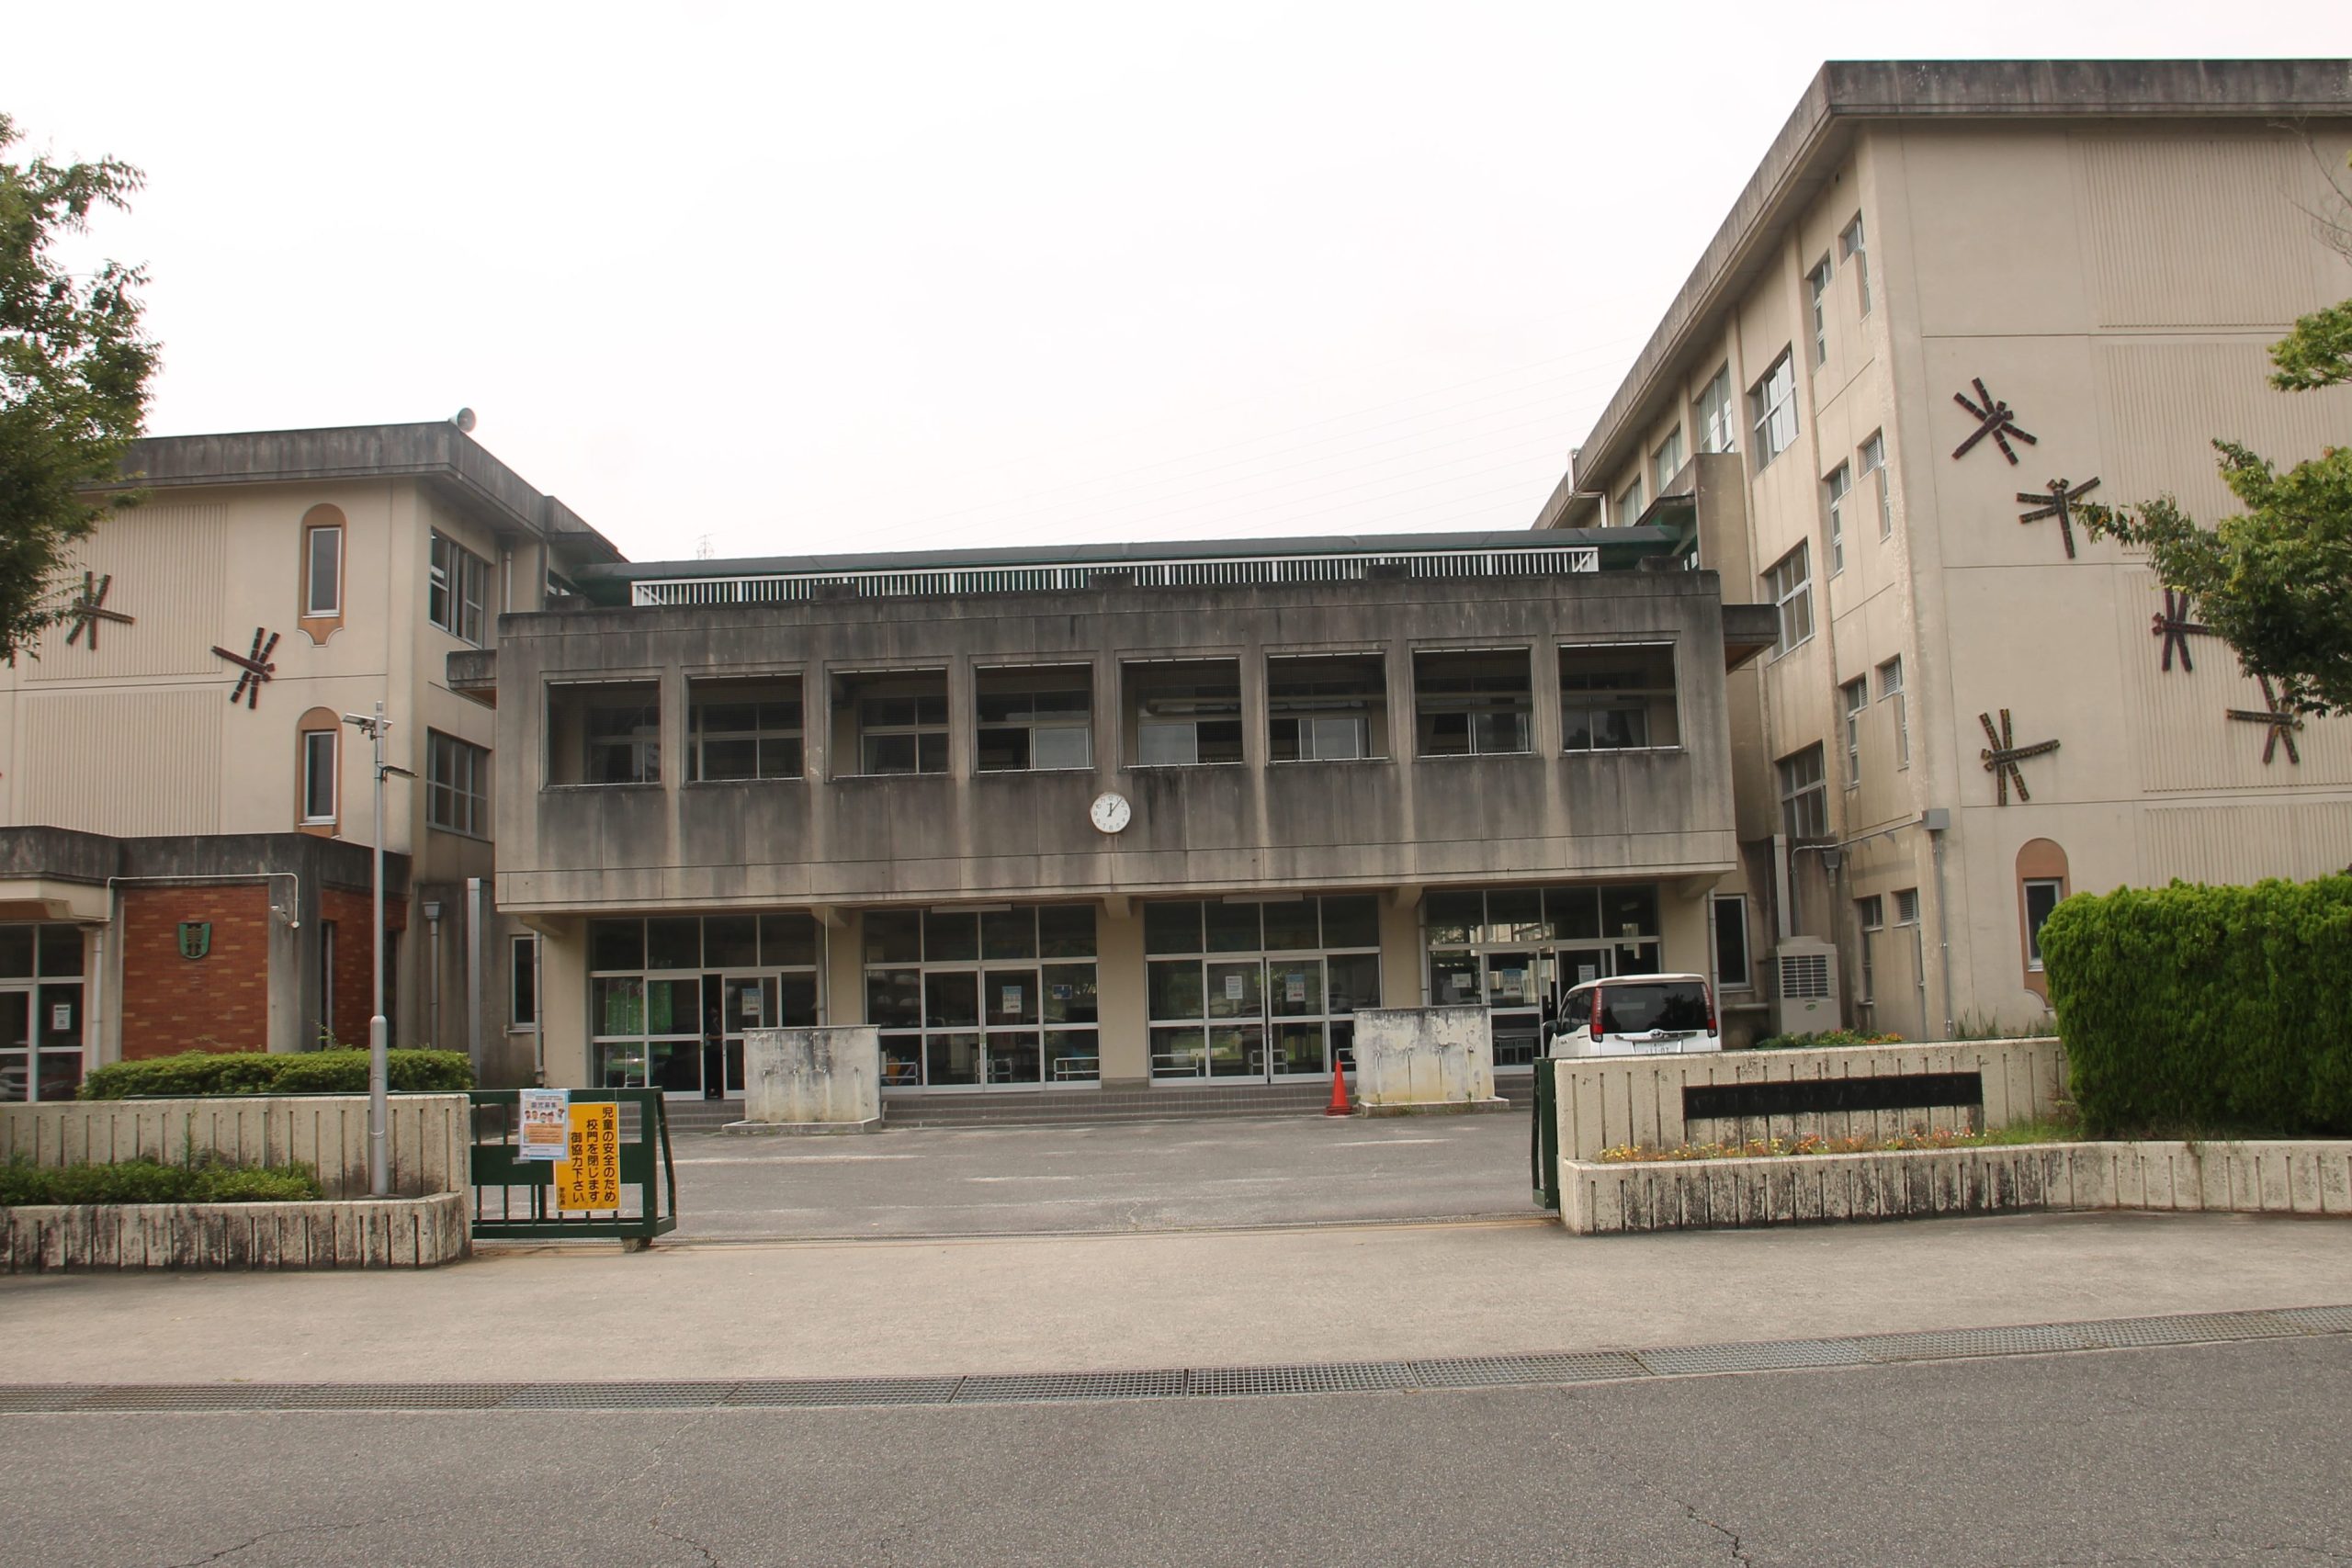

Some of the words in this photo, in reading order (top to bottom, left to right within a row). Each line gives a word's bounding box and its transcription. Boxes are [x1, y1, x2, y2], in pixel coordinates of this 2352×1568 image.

[571, 1132, 584, 1202] 御協力下さい
[586, 1119, 600, 1202] 校門を閉じます
[603, 1107, 616, 1202] 児童の安全のため
